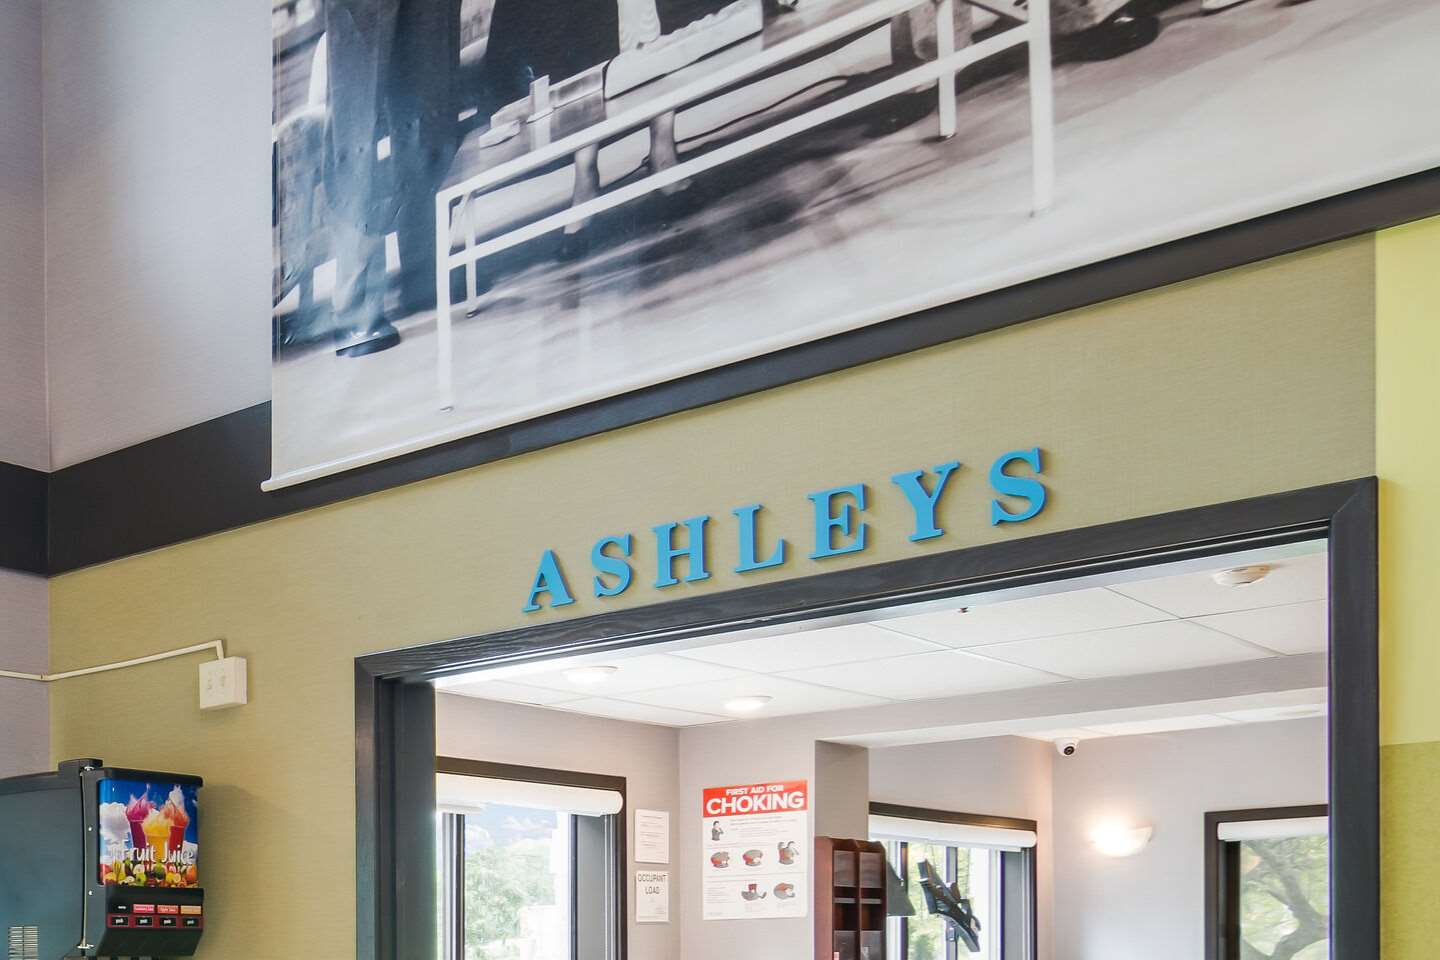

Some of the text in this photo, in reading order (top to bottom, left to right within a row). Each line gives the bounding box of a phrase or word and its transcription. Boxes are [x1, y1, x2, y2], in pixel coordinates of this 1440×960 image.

[523, 446, 1048, 613] ASHLEYS
[726, 784, 784, 796] FIRST AID FOR
[705, 791, 805, 815] CHOKING
[122, 839, 194, 866] Fruit Juice
[637, 874, 667, 883] OCCUPANT
[644, 886, 661, 895] LOAD
